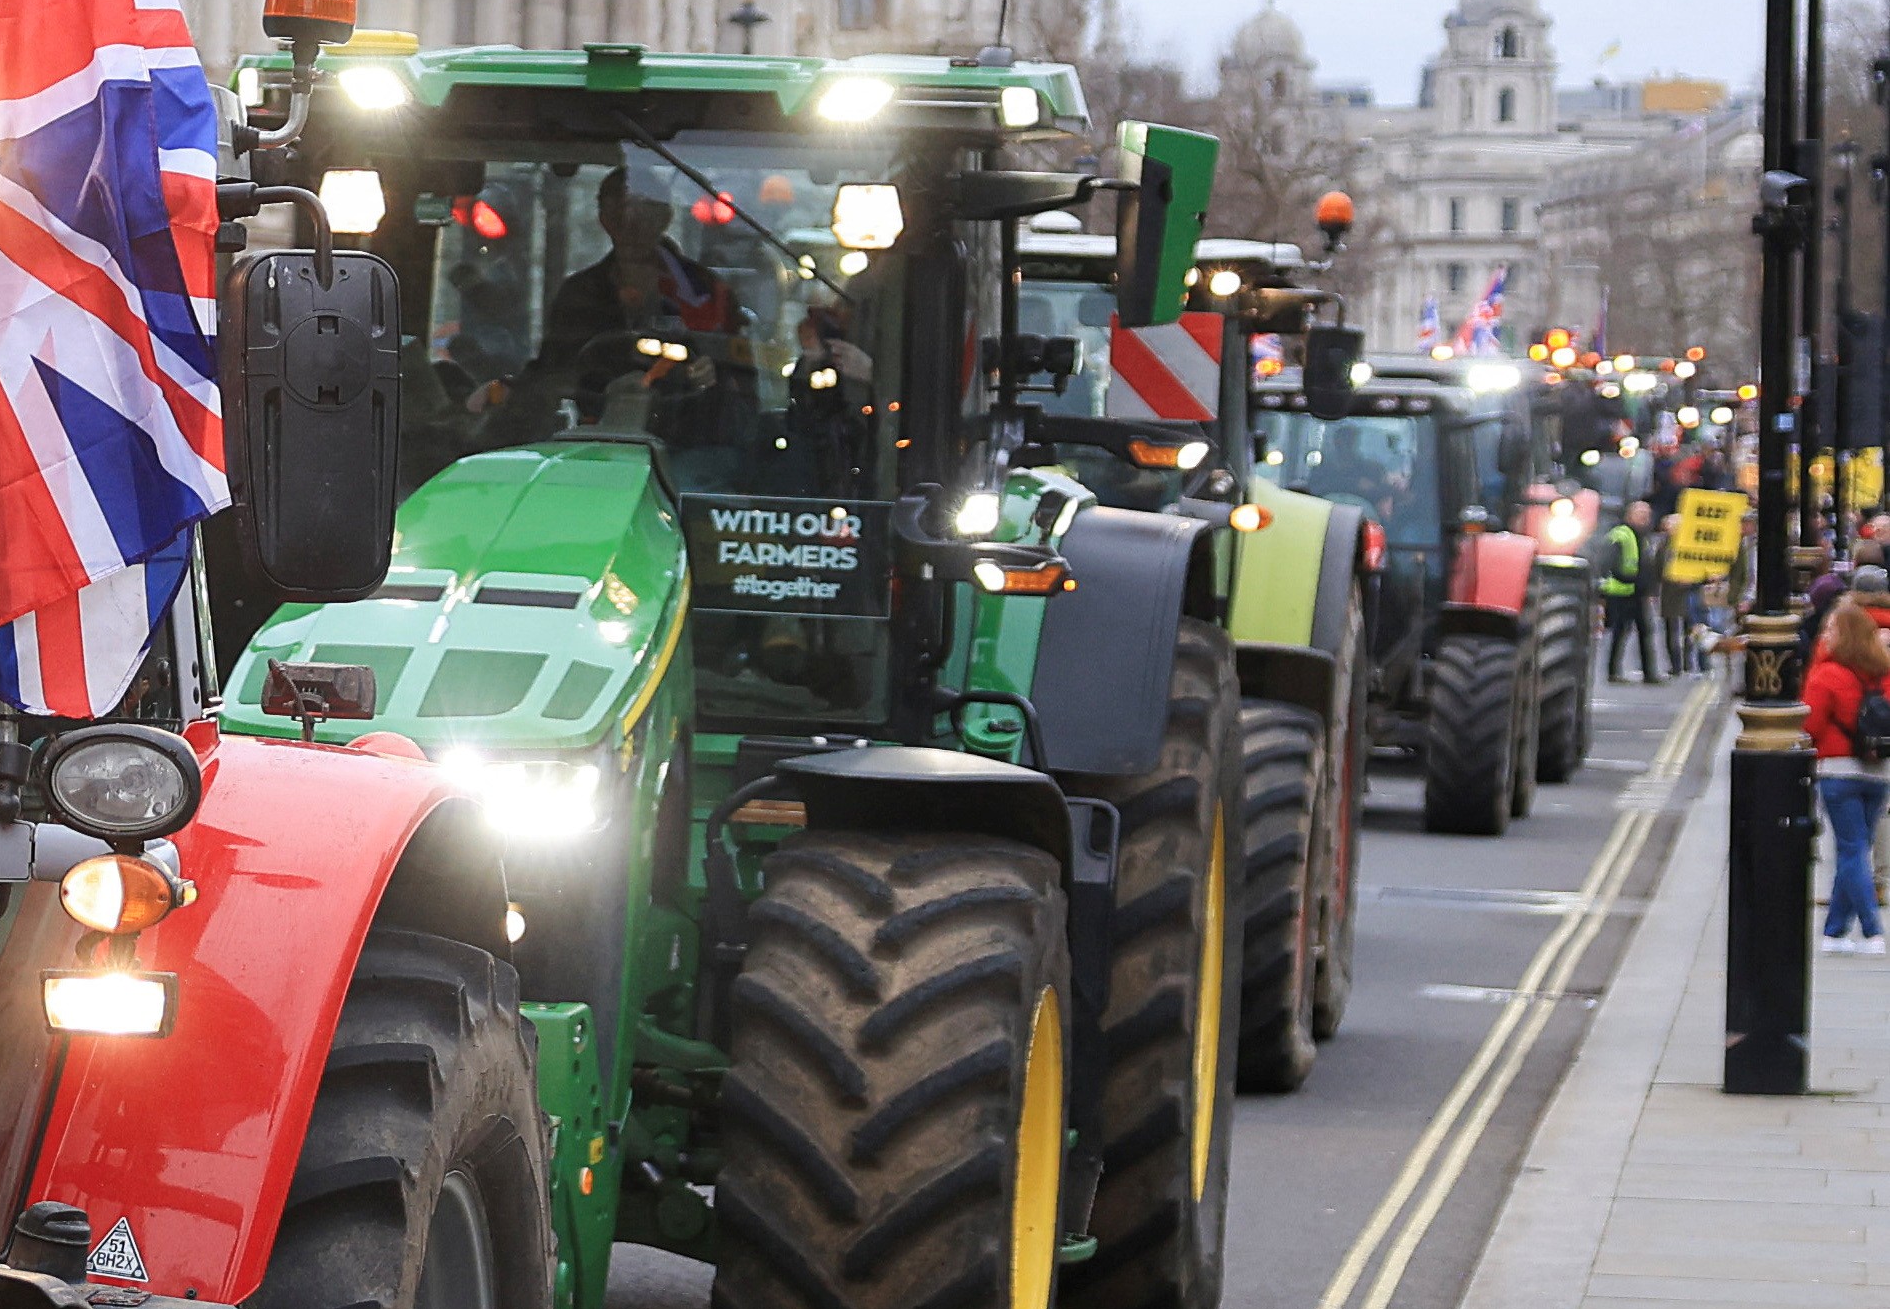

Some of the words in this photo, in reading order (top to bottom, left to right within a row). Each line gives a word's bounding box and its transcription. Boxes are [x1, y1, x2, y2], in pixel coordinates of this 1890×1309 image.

[710, 508, 790, 535] WITH
[796, 512, 862, 539] OUR
[719, 541, 859, 570] FARMERS
[733, 574, 841, 602] #together
[109, 1238, 126, 1254] 51
[96, 1251, 134, 1271] BH2X
